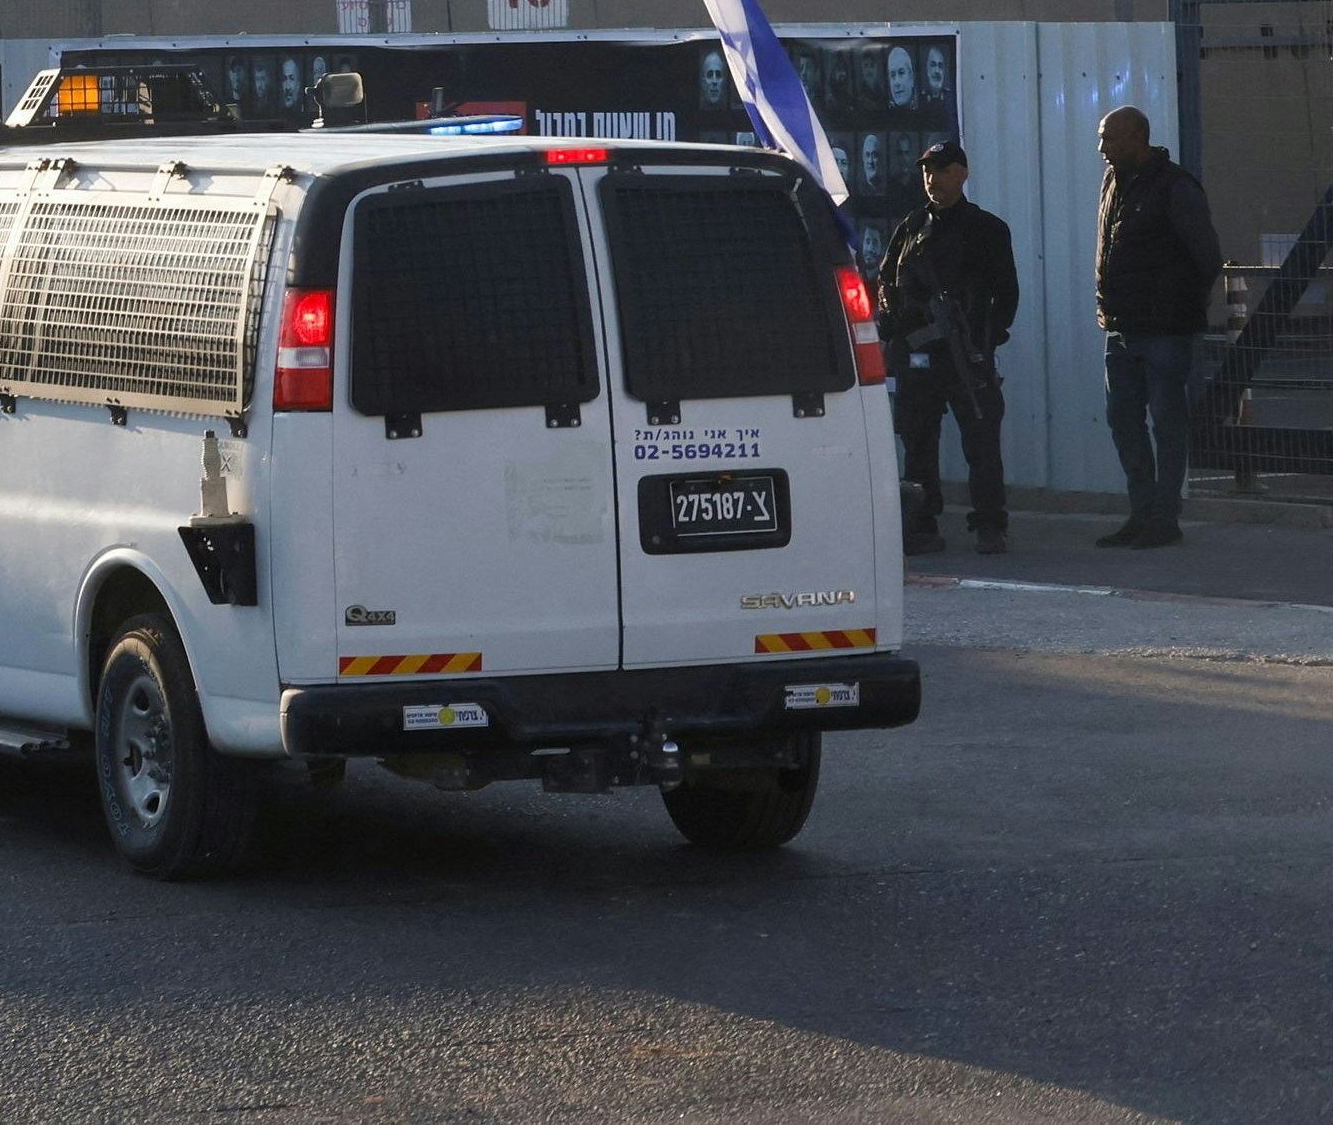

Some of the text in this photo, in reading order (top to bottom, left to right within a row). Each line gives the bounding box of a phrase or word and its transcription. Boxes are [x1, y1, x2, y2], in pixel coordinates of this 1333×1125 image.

[704, 429, 727, 439] אני
[736, 428, 760, 441] איך
[634, 443, 760, 460] 02-5694211
[741, 590, 855, 609] SAVANA
